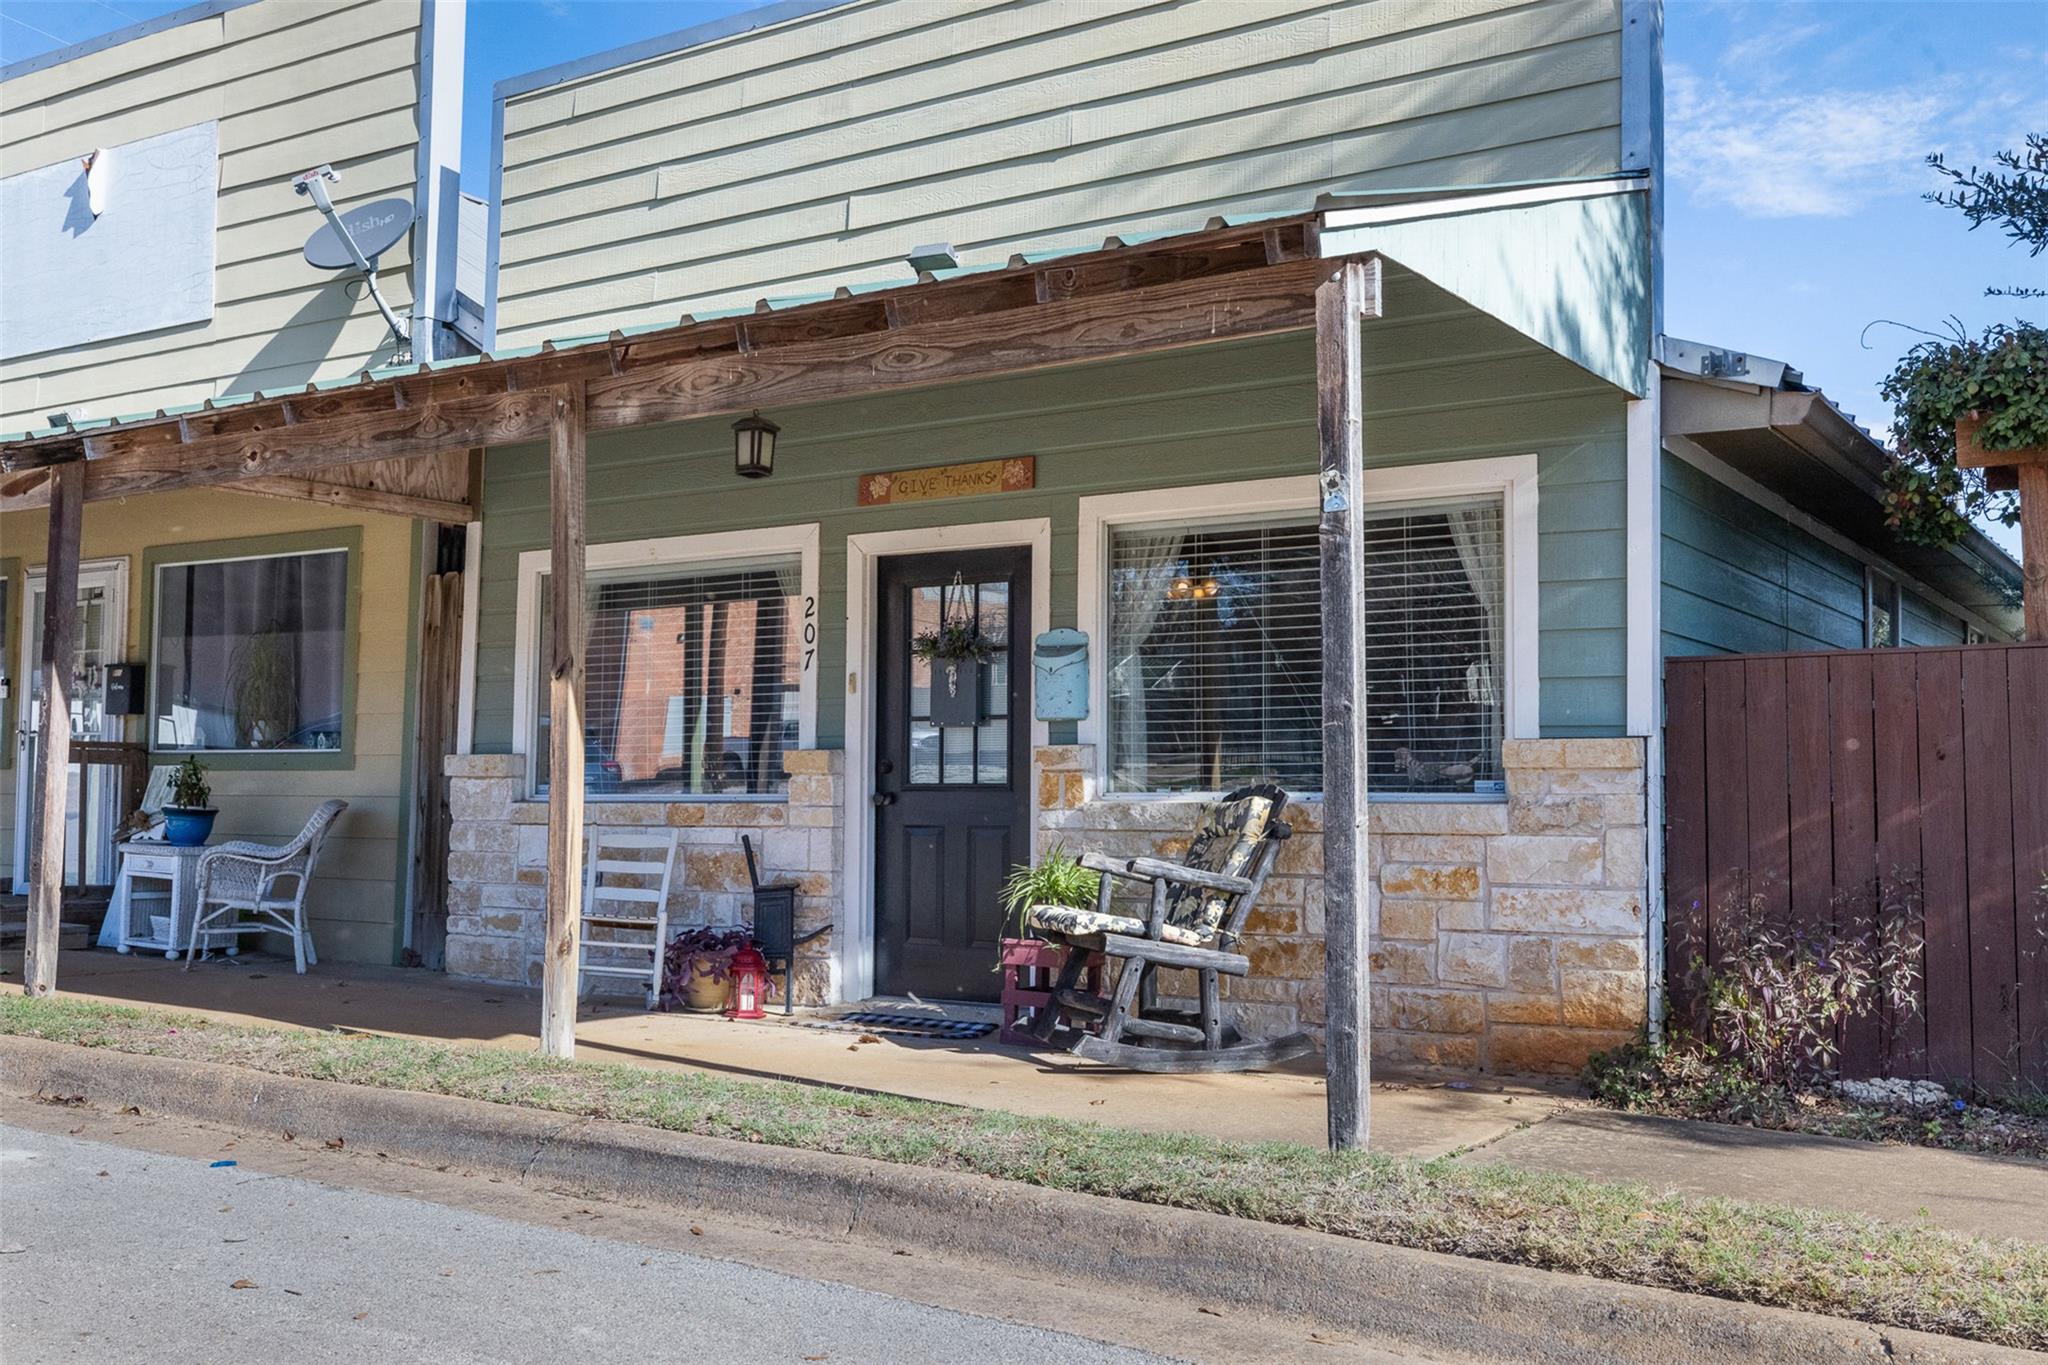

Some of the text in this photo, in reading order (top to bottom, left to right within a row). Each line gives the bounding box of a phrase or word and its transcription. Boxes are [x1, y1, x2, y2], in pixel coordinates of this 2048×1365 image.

[899, 470, 993, 494] GIVE THANKS
[804, 596, 816, 672] 207
